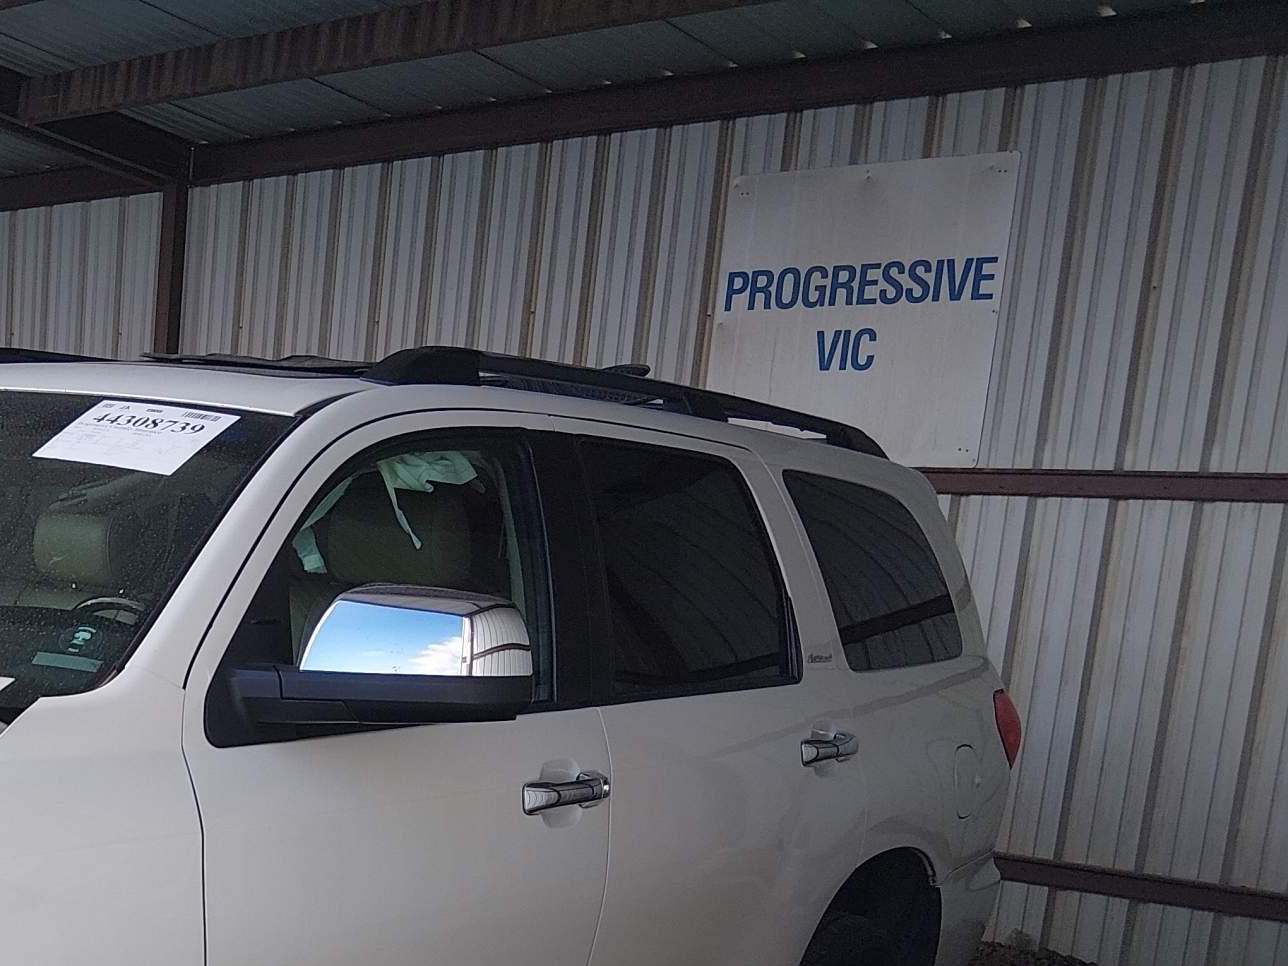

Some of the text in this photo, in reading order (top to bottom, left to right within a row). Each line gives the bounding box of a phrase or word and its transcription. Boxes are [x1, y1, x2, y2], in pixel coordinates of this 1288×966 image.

[724, 256, 999, 312] PROGRESSIVE
[816, 327, 878, 372] VIC
[93, 412, 205, 434] 44308739
